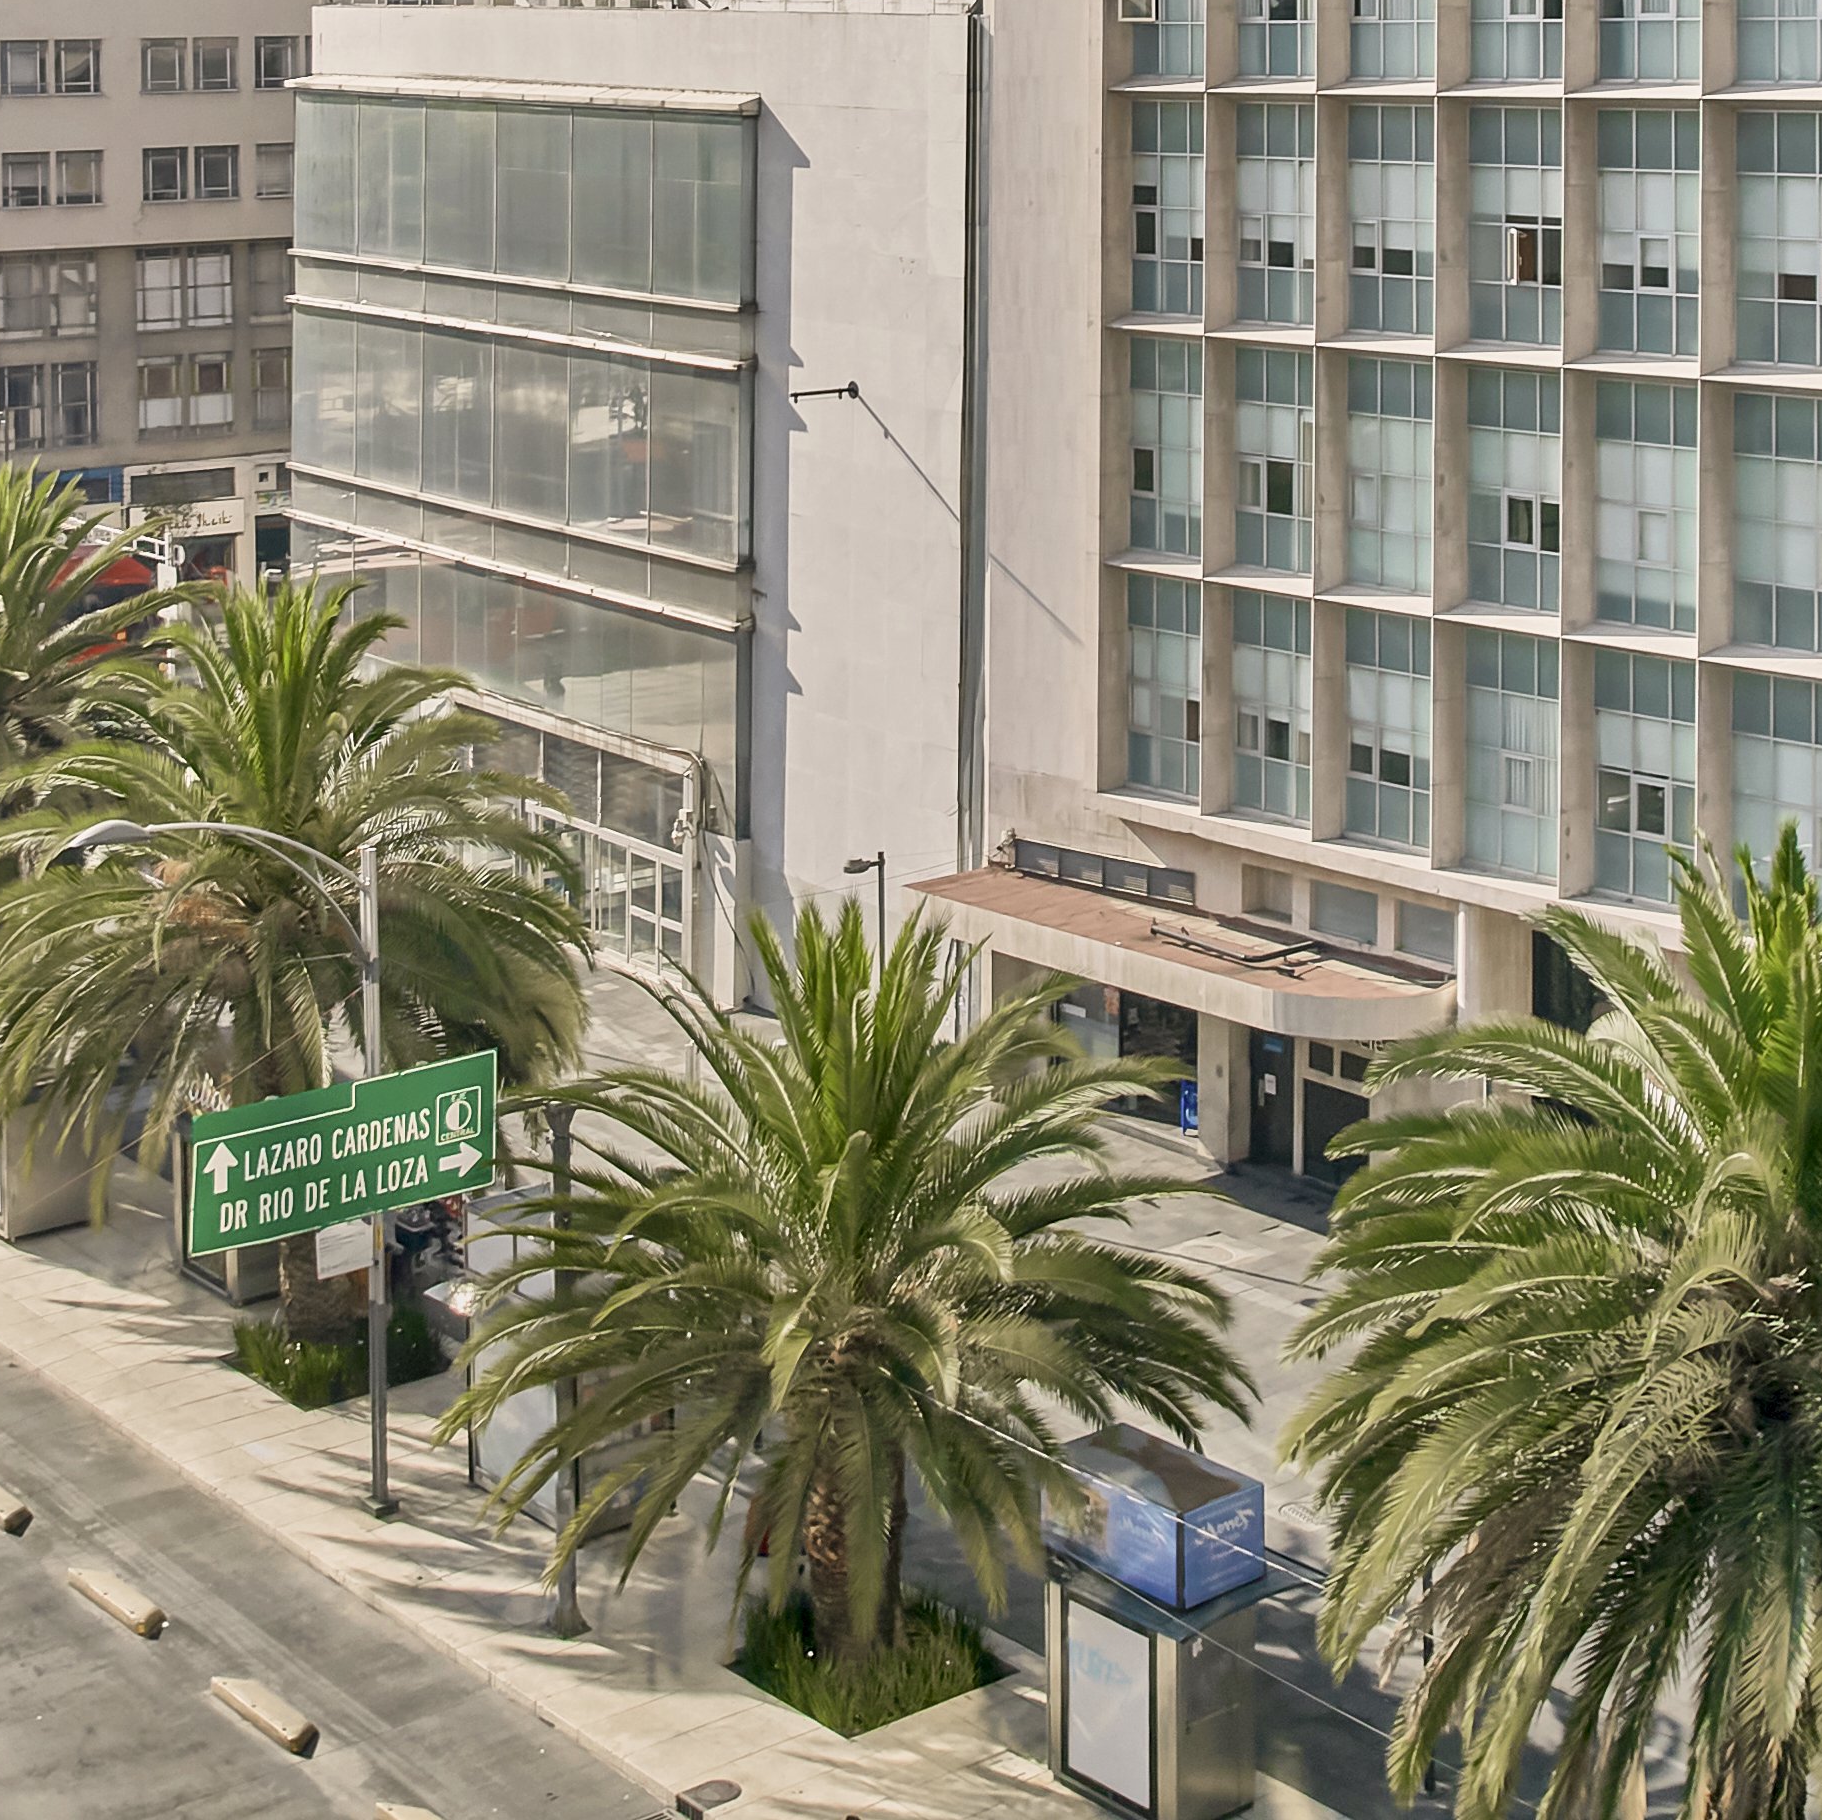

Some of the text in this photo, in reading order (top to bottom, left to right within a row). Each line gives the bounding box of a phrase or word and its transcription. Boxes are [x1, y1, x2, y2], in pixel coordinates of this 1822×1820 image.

[244, 1107, 431, 1182] LAZARO CARDENAS
[440, 1126, 476, 1141] CENTRAL
[219, 1154, 429, 1234] DR RIO DE LA LOZA
